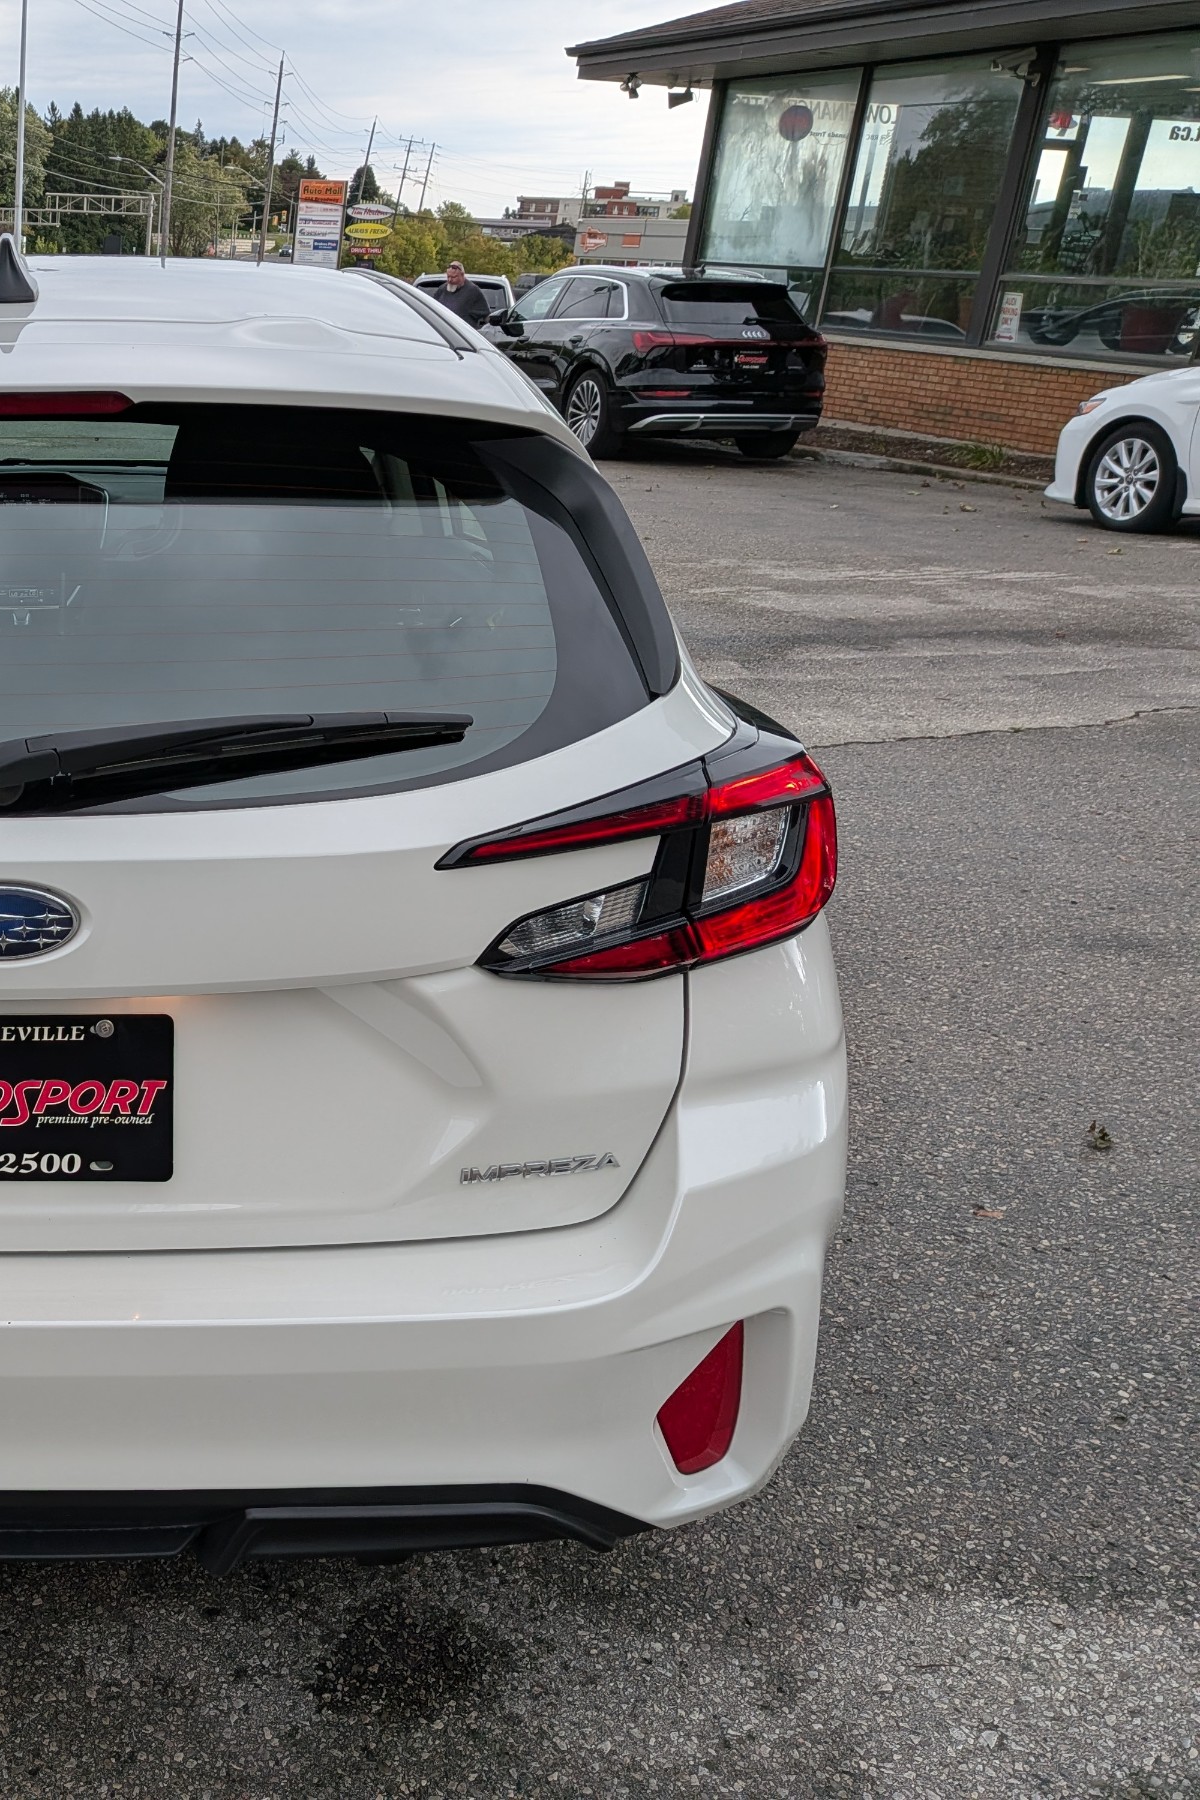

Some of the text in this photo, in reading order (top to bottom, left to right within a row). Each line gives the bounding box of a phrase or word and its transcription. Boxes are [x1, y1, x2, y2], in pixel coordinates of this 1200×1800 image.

[303, 185, 343, 195] Auto Mall
[35, 1112, 153, 1128] premium pre-owned
[459, 1151, 621, 1185] IMPREZA
